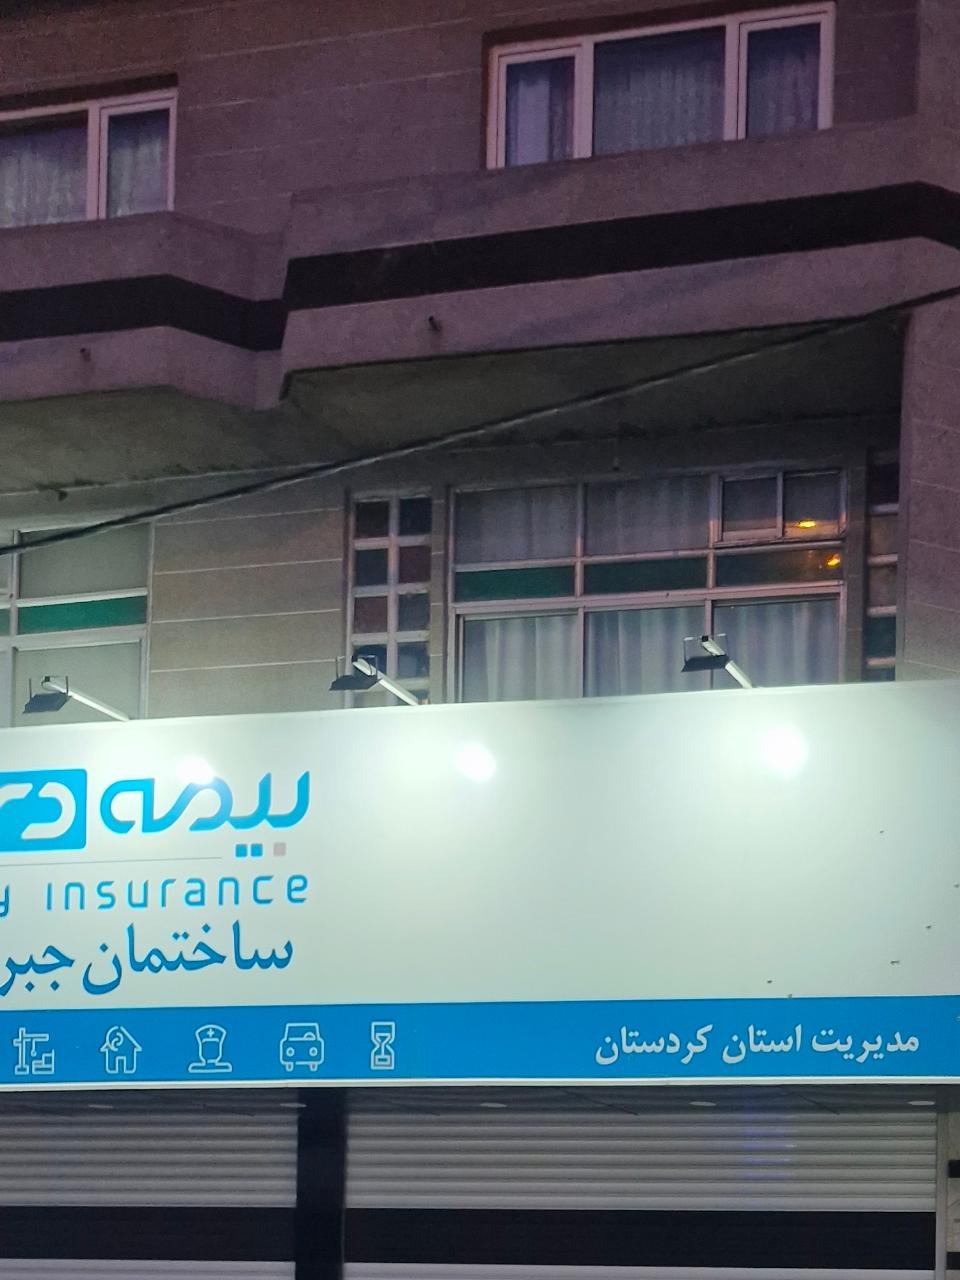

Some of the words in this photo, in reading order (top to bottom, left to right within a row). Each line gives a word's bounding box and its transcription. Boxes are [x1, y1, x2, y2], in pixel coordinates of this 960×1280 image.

[100, 770, 310, 858] بیمه
[46, 874, 309, 911] insurance
[0, 944, 75, 997] جبر
[82, 919, 294, 995] ساختمان
[594, 1024, 714, 1066] کردستان
[721, 1024, 802, 1065] استان
[811, 1027, 920, 1063] مدیریت
